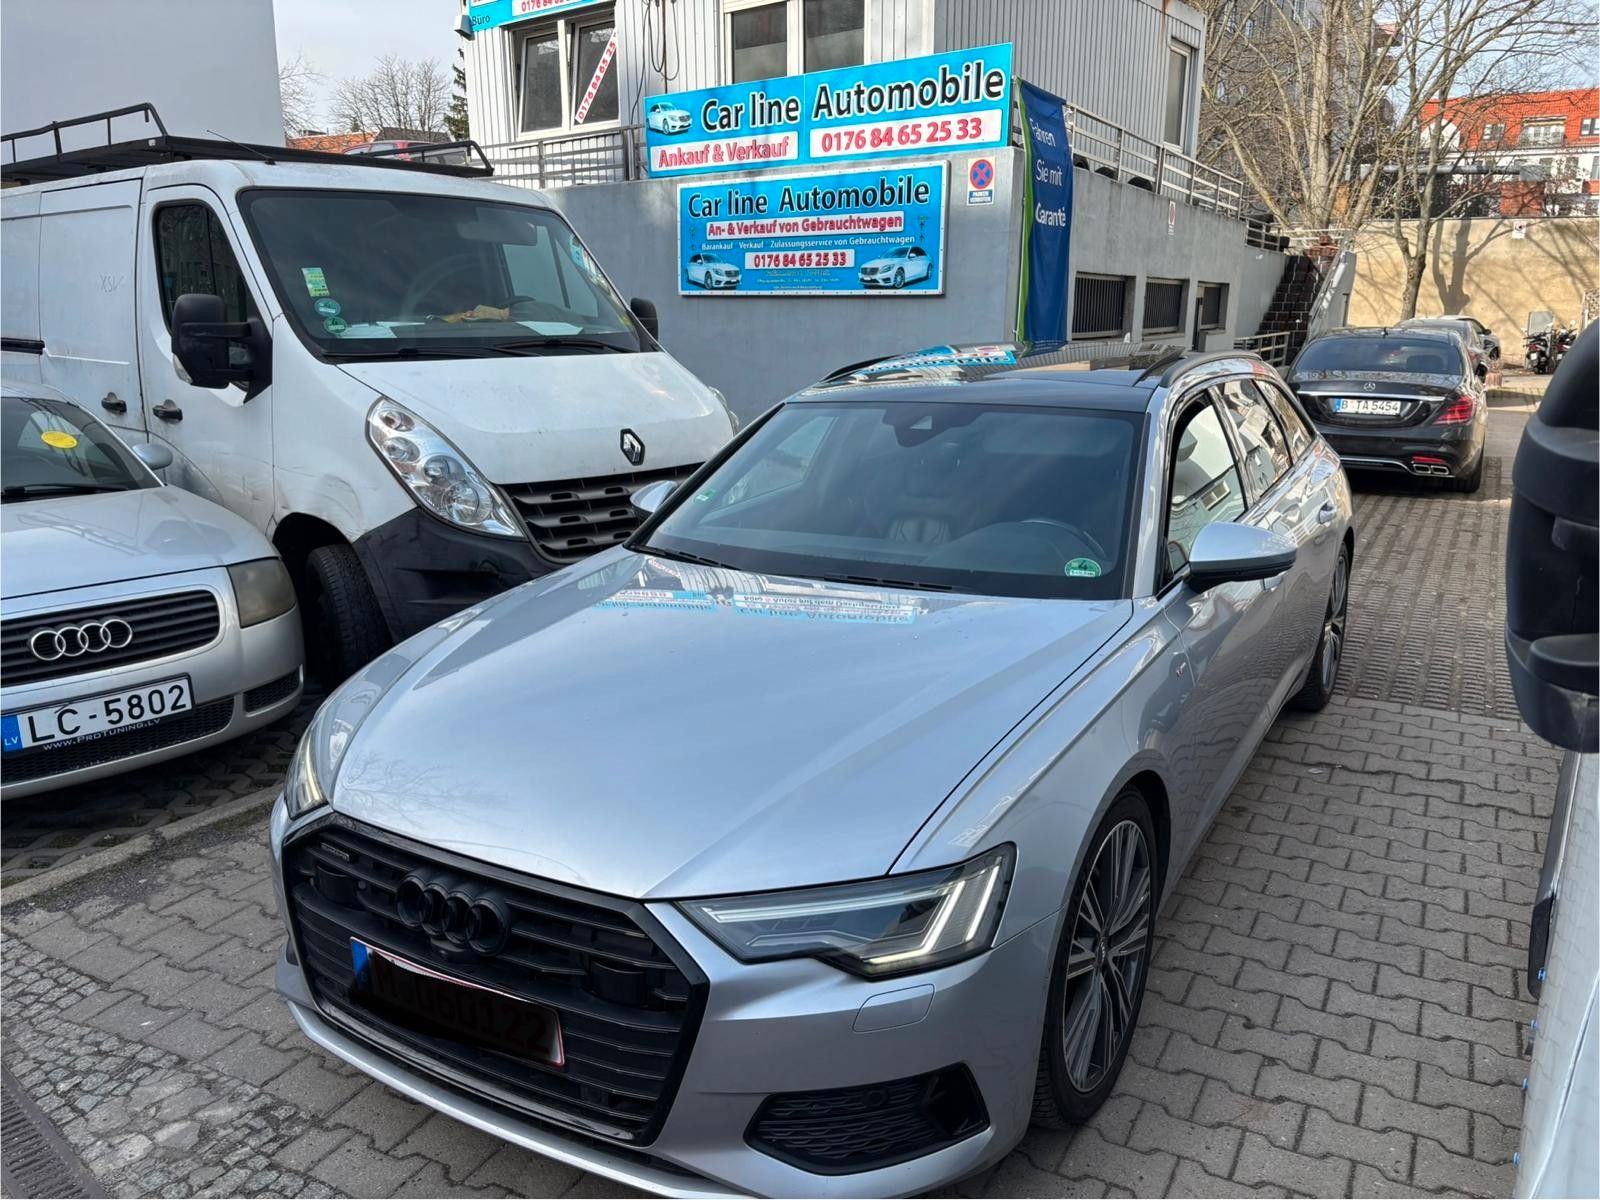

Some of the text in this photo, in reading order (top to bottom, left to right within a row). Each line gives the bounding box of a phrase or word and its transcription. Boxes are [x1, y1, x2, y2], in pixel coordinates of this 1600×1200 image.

[521, 0, 540, 12] 0176
[471, 14, 490, 26] Büro
[578, 91, 594, 120] 0176
[599, 58, 608, 73] 65
[702, 62, 1004, 131] Car line Automobile
[821, 117, 982, 153] 0176 84 65 25 33
[658, 136, 790, 168] Ankauf & Verkauf
[1036, 160, 1062, 186] Sie mit
[688, 174, 930, 218] Car line Automobile
[708, 224, 726, 236] An-
[727, 222, 735, 235] &
[736, 220, 778, 234] Verkauf
[778, 222, 798, 232] von
[801, 215, 902, 232] Gebrauchtwagen
[702, 240, 734, 250] Barankauf
[738, 240, 764, 249] Verkauf
[770, 240, 832, 249] Zulassungsservice
[849, 236, 915, 246] Gebrauchtwagen
[754, 252, 847, 268] 0176 84 65 25 33
[1342, 400, 1398, 411] B TA 5454
[1078, 560, 1088, 570] 4
[28, 684, 187, 744] LC-5802
[4, 736, 18, 746] LV
